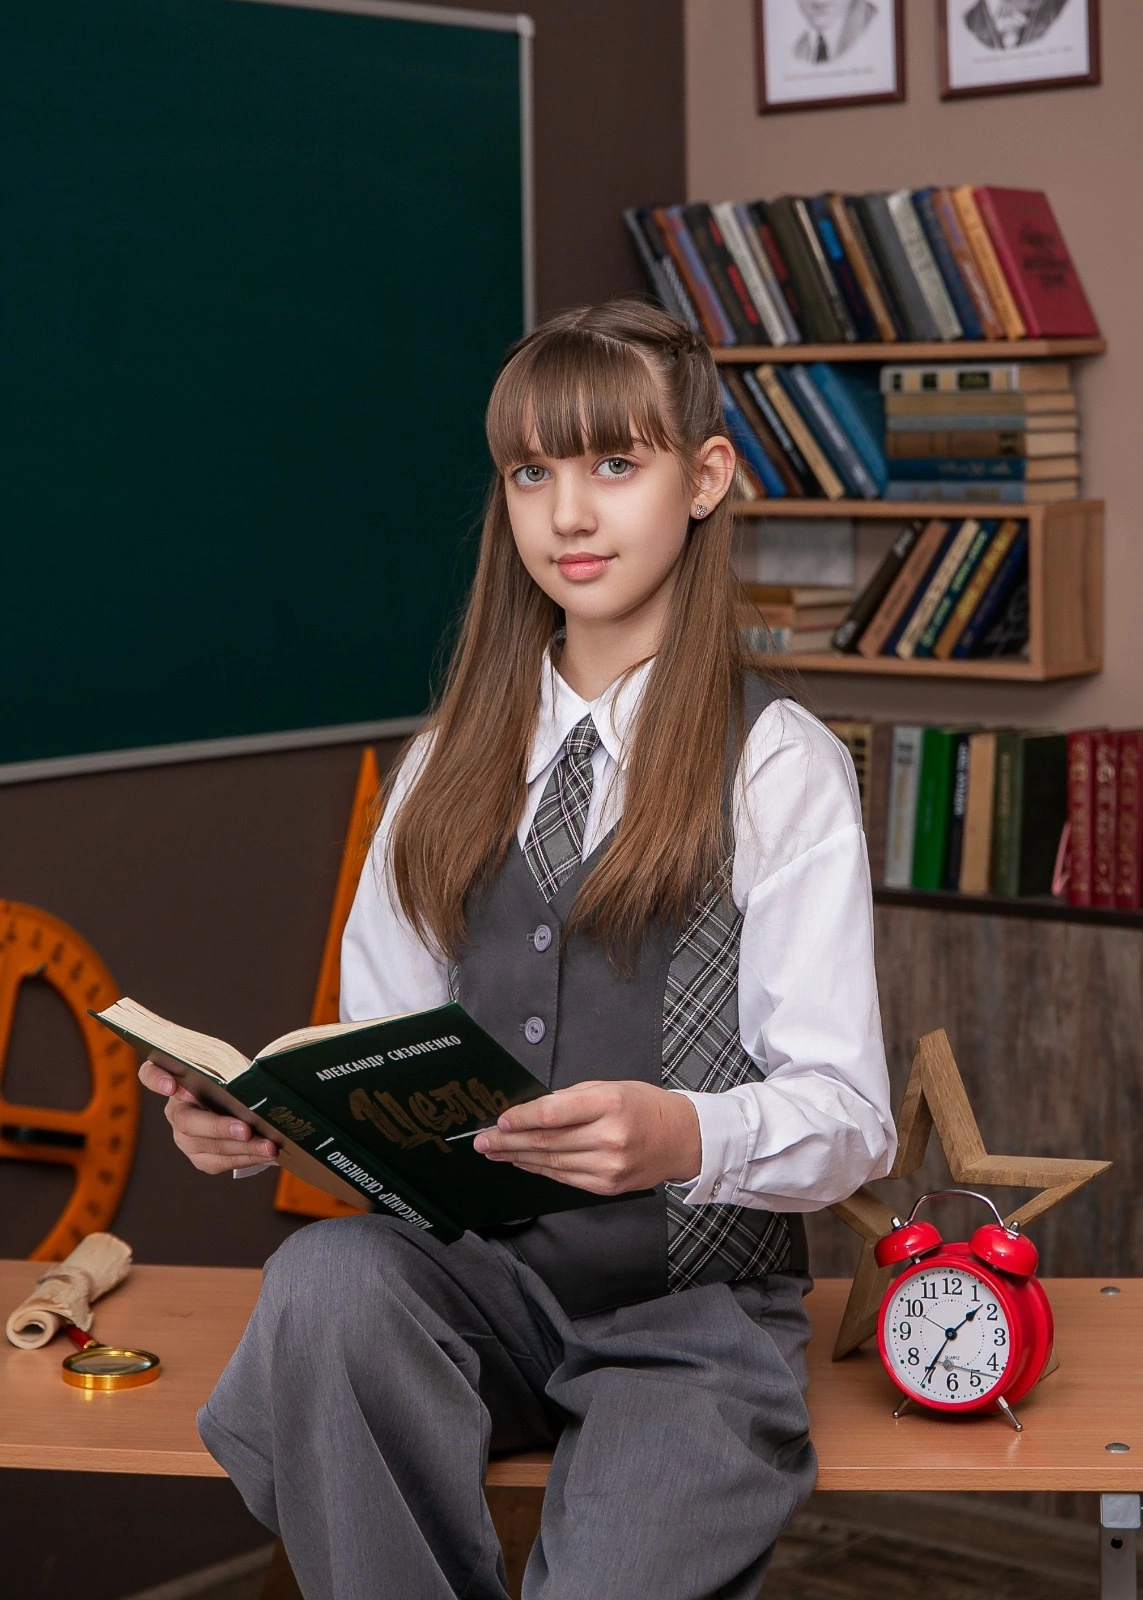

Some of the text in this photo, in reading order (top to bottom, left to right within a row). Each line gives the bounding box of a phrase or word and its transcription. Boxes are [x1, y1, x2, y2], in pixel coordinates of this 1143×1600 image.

[315, 1034, 462, 1082] АЛЕКСАНДР СИЗОНЕНКО
[327, 1151, 434, 1230] АЛЕКСАНДР СИЗОНЕНКО
[921, 1281, 939, 1300] 11
[942, 1277, 963, 1296] 12
[970, 1284, 981, 1302] 1
[904, 1299, 924, 1318] 10
[986, 1303, 998, 1321] 2
[899, 1321, 912, 1341] 9
[993, 1327, 1006, 1346] 3
[907, 1347, 920, 1366] 8
[986, 1352, 999, 1372] 4
[924, 1366, 937, 1384] 7
[946, 1372, 959, 1392] 6
[969, 1369, 982, 1388] 5
